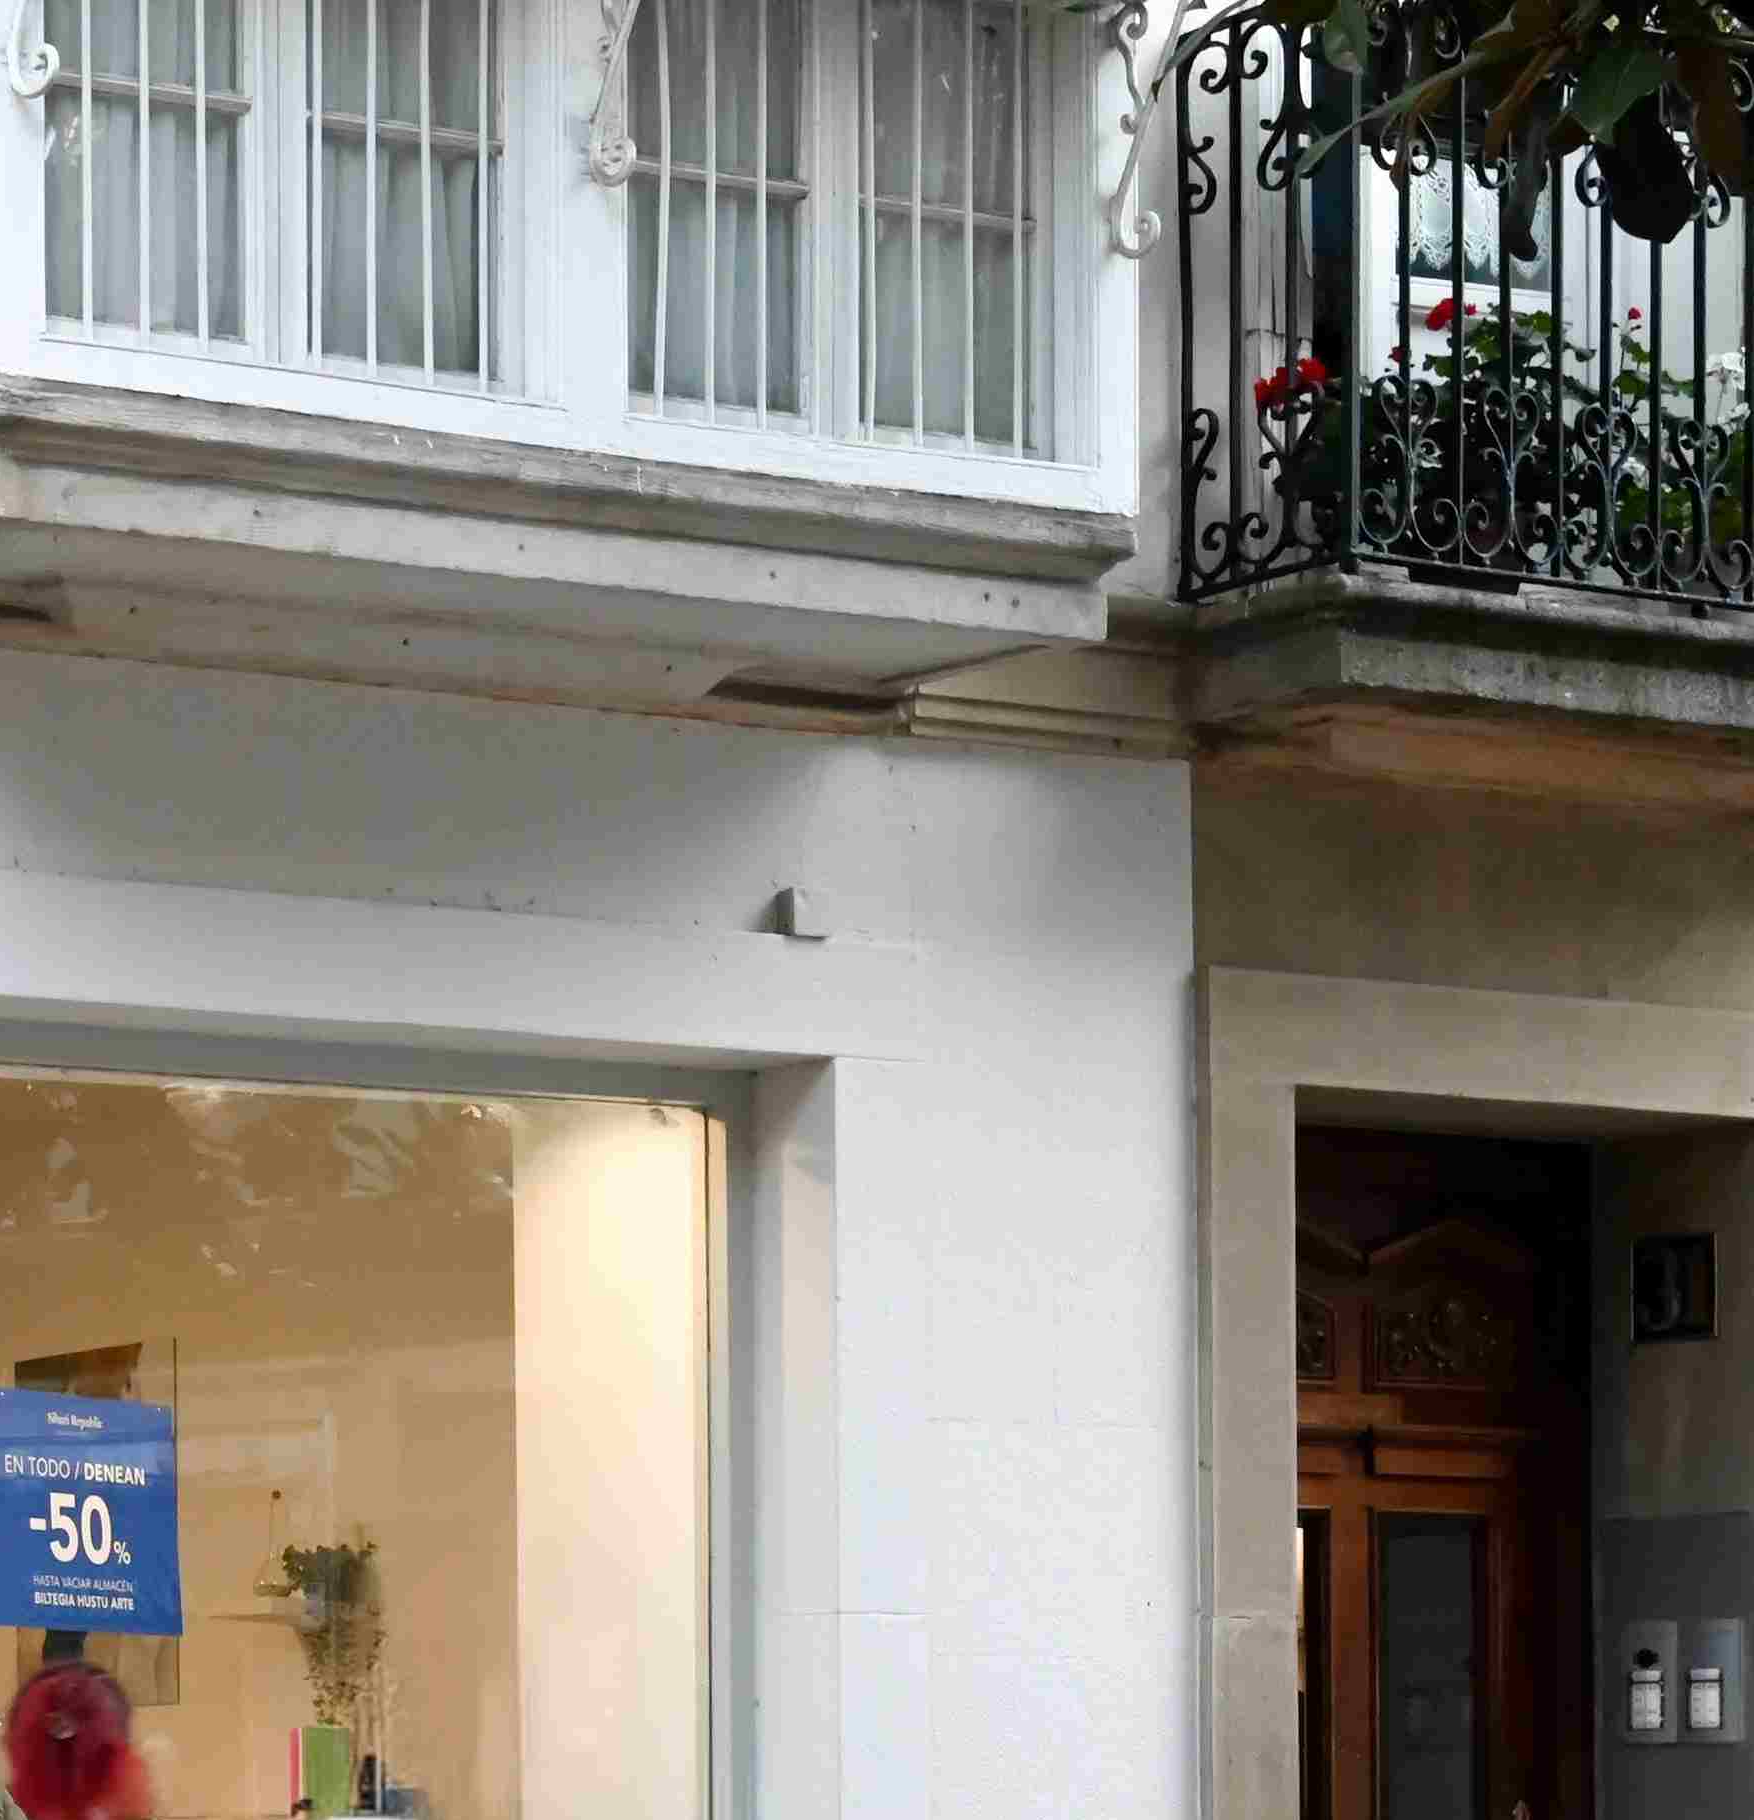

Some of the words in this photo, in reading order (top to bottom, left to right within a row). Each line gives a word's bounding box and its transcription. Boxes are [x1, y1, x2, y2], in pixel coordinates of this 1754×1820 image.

[4, 1454, 24, 1474] EN
[28, 1456, 71, 1479] TODO
[74, 1461, 81, 1481] /
[84, 1462, 146, 1486] DENEAN
[29, 1491, 132, 1566] -50%
[33, 1575, 61, 1587] HASTA
[35, 1591, 75, 1607] BILTEGIA
[77, 1594, 108, 1609] HUSTU
[111, 1596, 134, 1611] ARTE
